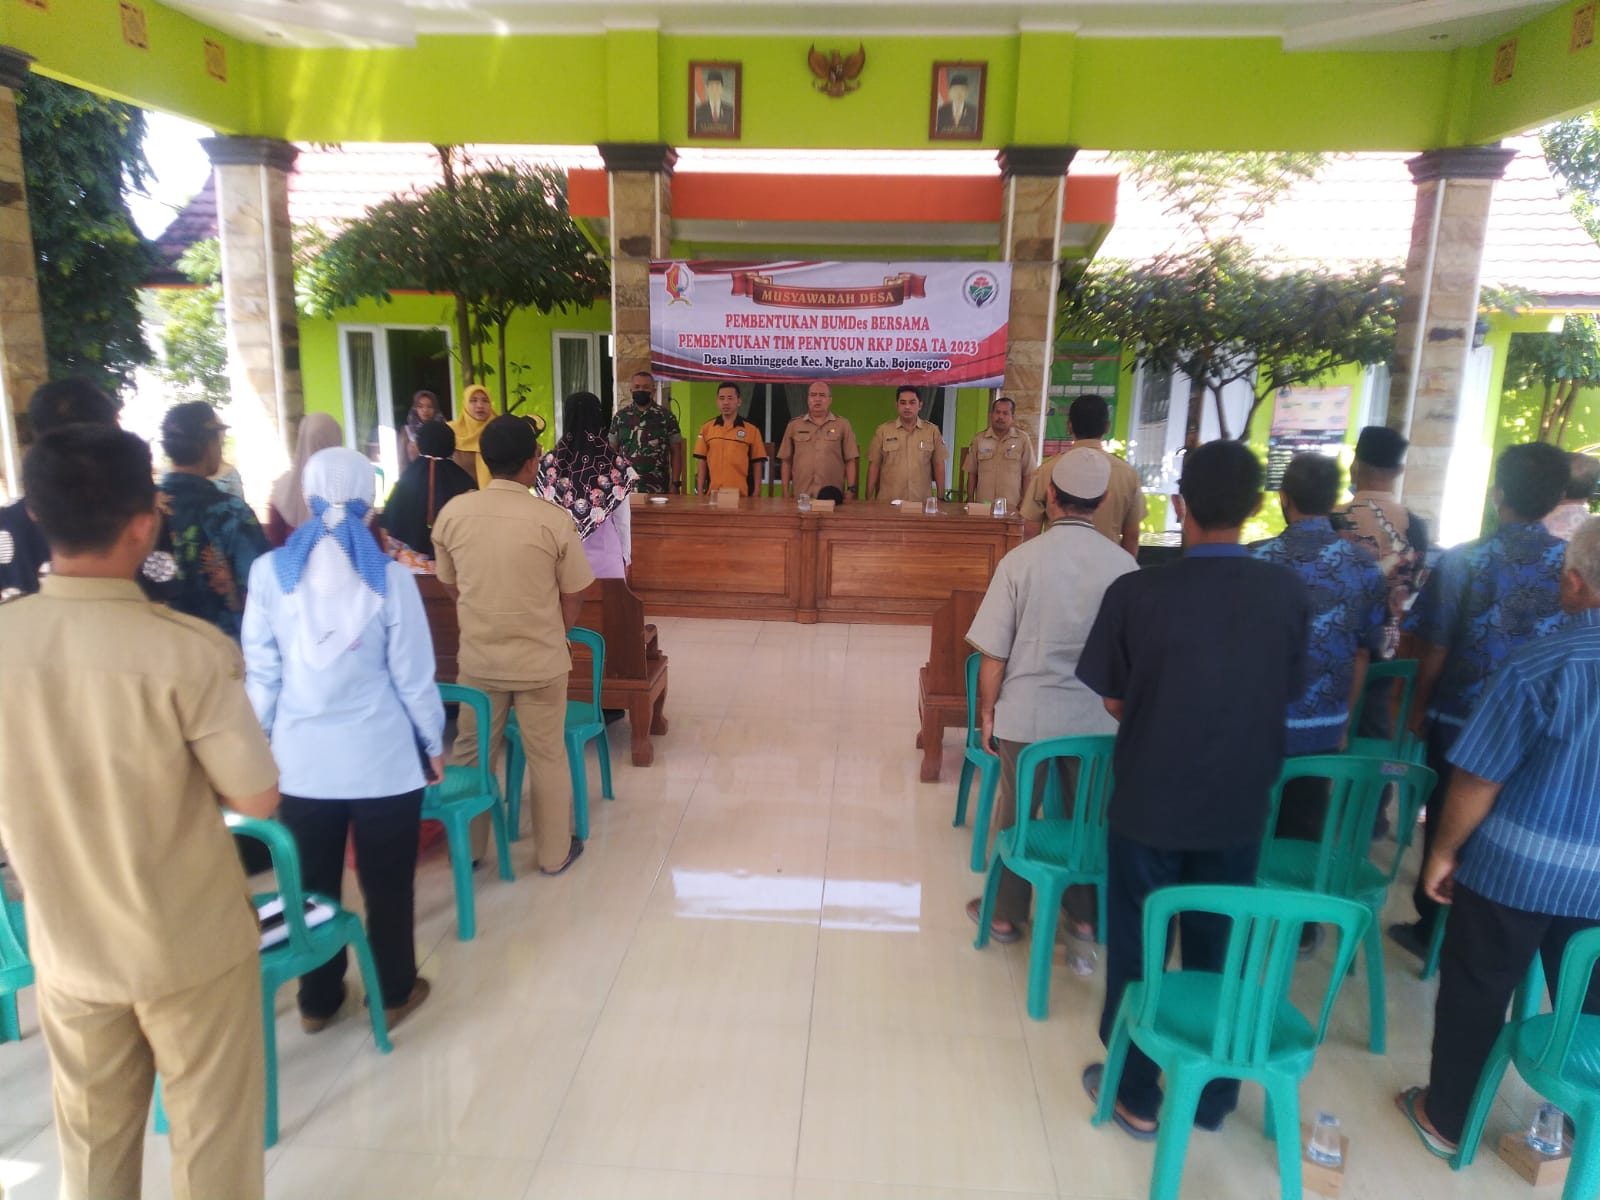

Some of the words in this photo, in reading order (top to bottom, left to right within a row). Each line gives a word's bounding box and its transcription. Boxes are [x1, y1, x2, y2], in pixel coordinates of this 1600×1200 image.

[762, 290, 855, 305] MUSYAWARAH
[860, 291, 895, 304] DESA
[725, 313, 819, 330] PEMBENTUKAN
[821, 315, 868, 331] BUMDes
[871, 316, 929, 331] BERSAMA
[679, 334, 771, 349] PEMBENTUKAN
[774, 335, 795, 350] TIM
[798, 336, 865, 351] PENYUSUN
[867, 337, 893, 351] RKP
[895, 338, 929, 352] DESA
[931, 339, 948, 353] TA
[950, 340, 977, 355] 2023
[704, 355, 727, 365] Desa
[730, 355, 799, 368] Blimbinggede
[801, 357, 821, 368] Kec.
[825, 357, 863, 370] Ngraho
[866, 358, 888, 368] Kab.
[892, 358, 950, 371] Bojonegoro
